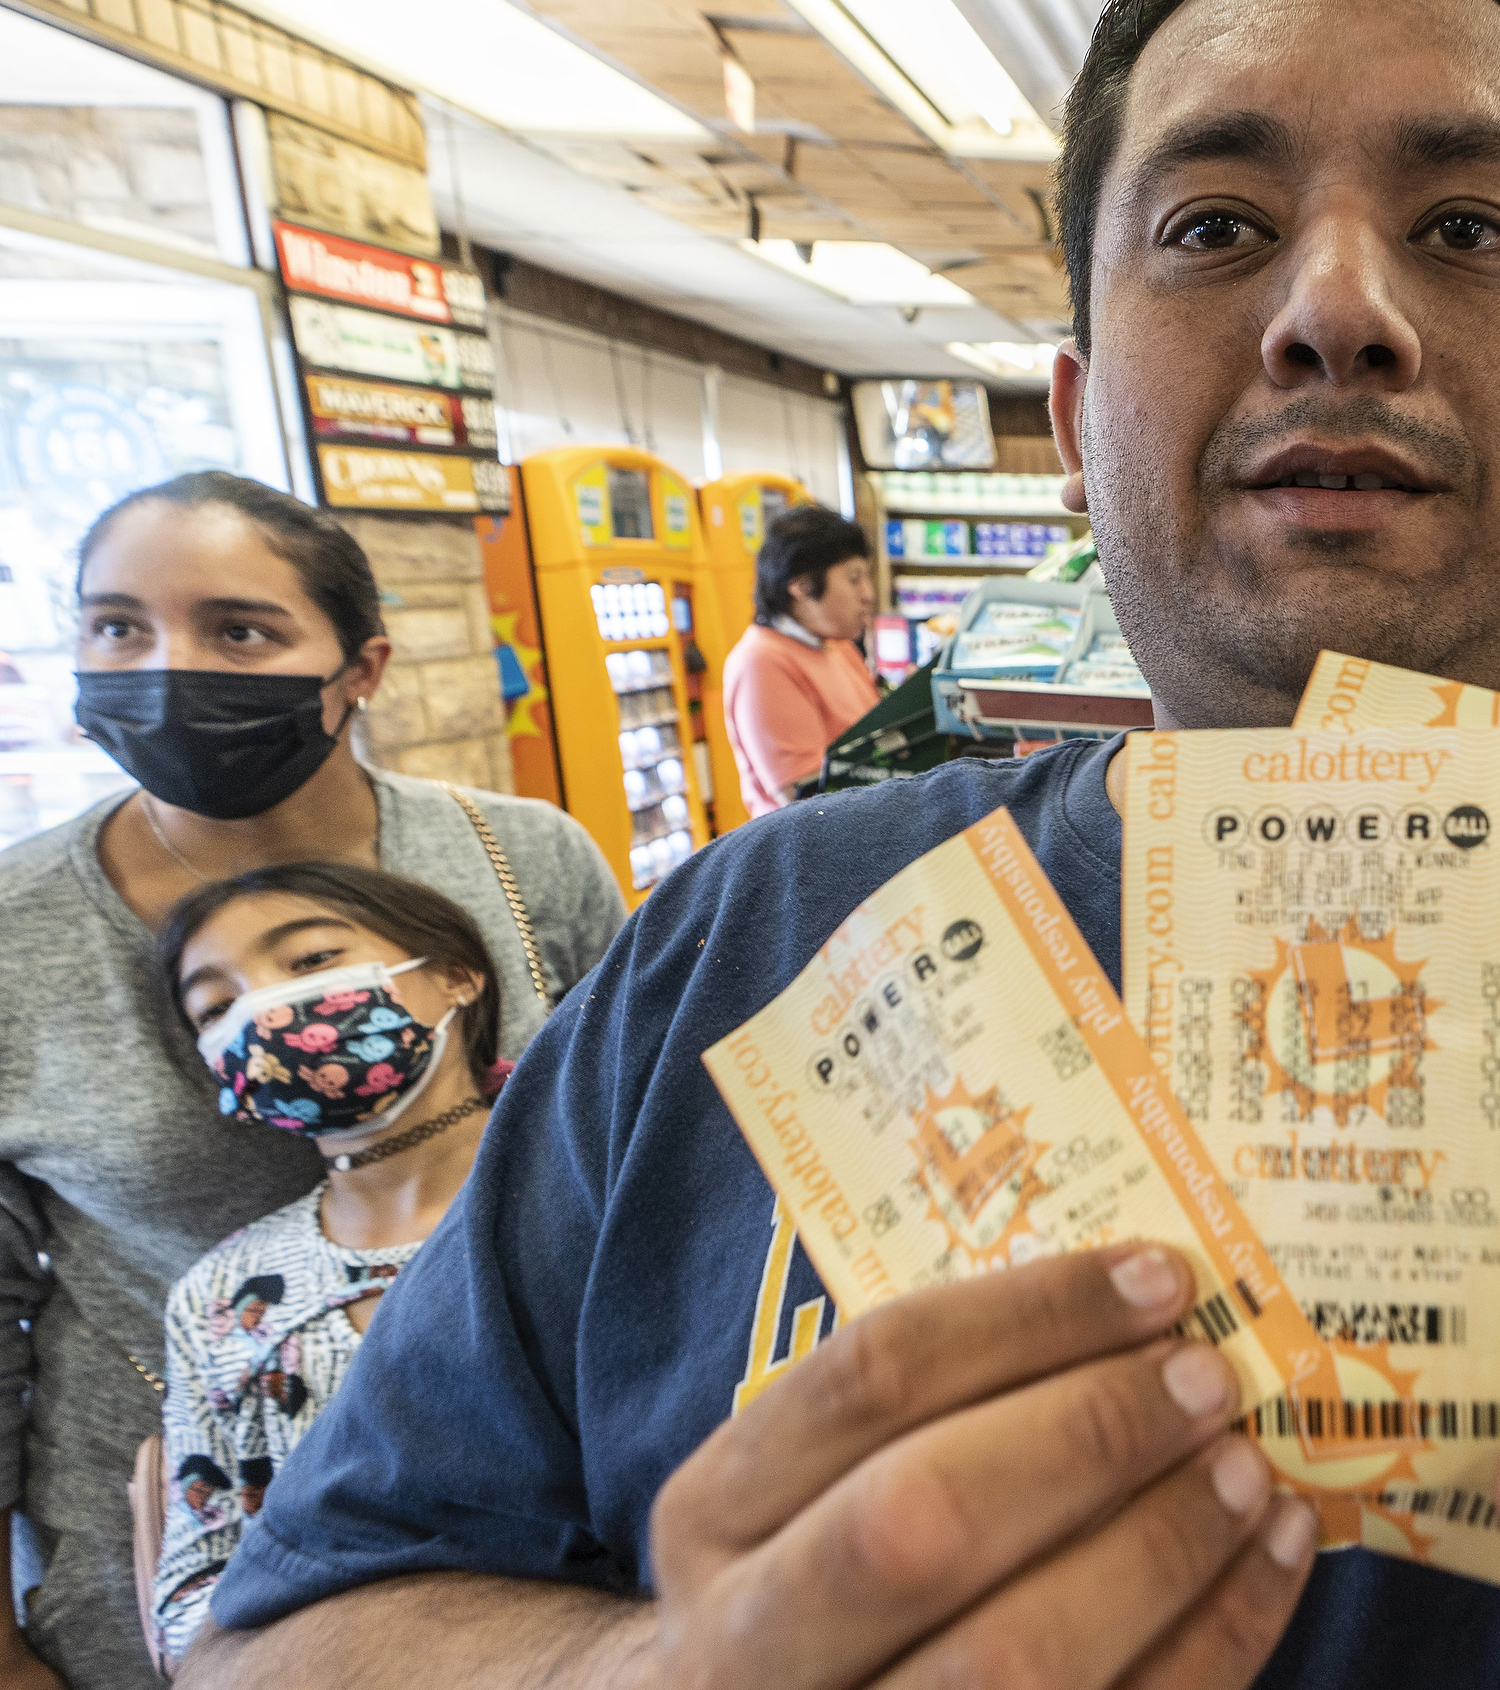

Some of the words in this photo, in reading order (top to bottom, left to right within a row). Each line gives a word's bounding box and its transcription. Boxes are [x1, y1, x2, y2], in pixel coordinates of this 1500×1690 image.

[1242, 738, 1452, 793] calottery
[1214, 812, 1432, 844] POWER
[976, 823, 1078, 975] responsibly
[1068, 964, 1122, 1037] play
[1126, 1073, 1233, 1238] responsibly
[1225, 1238, 1283, 1309] play
